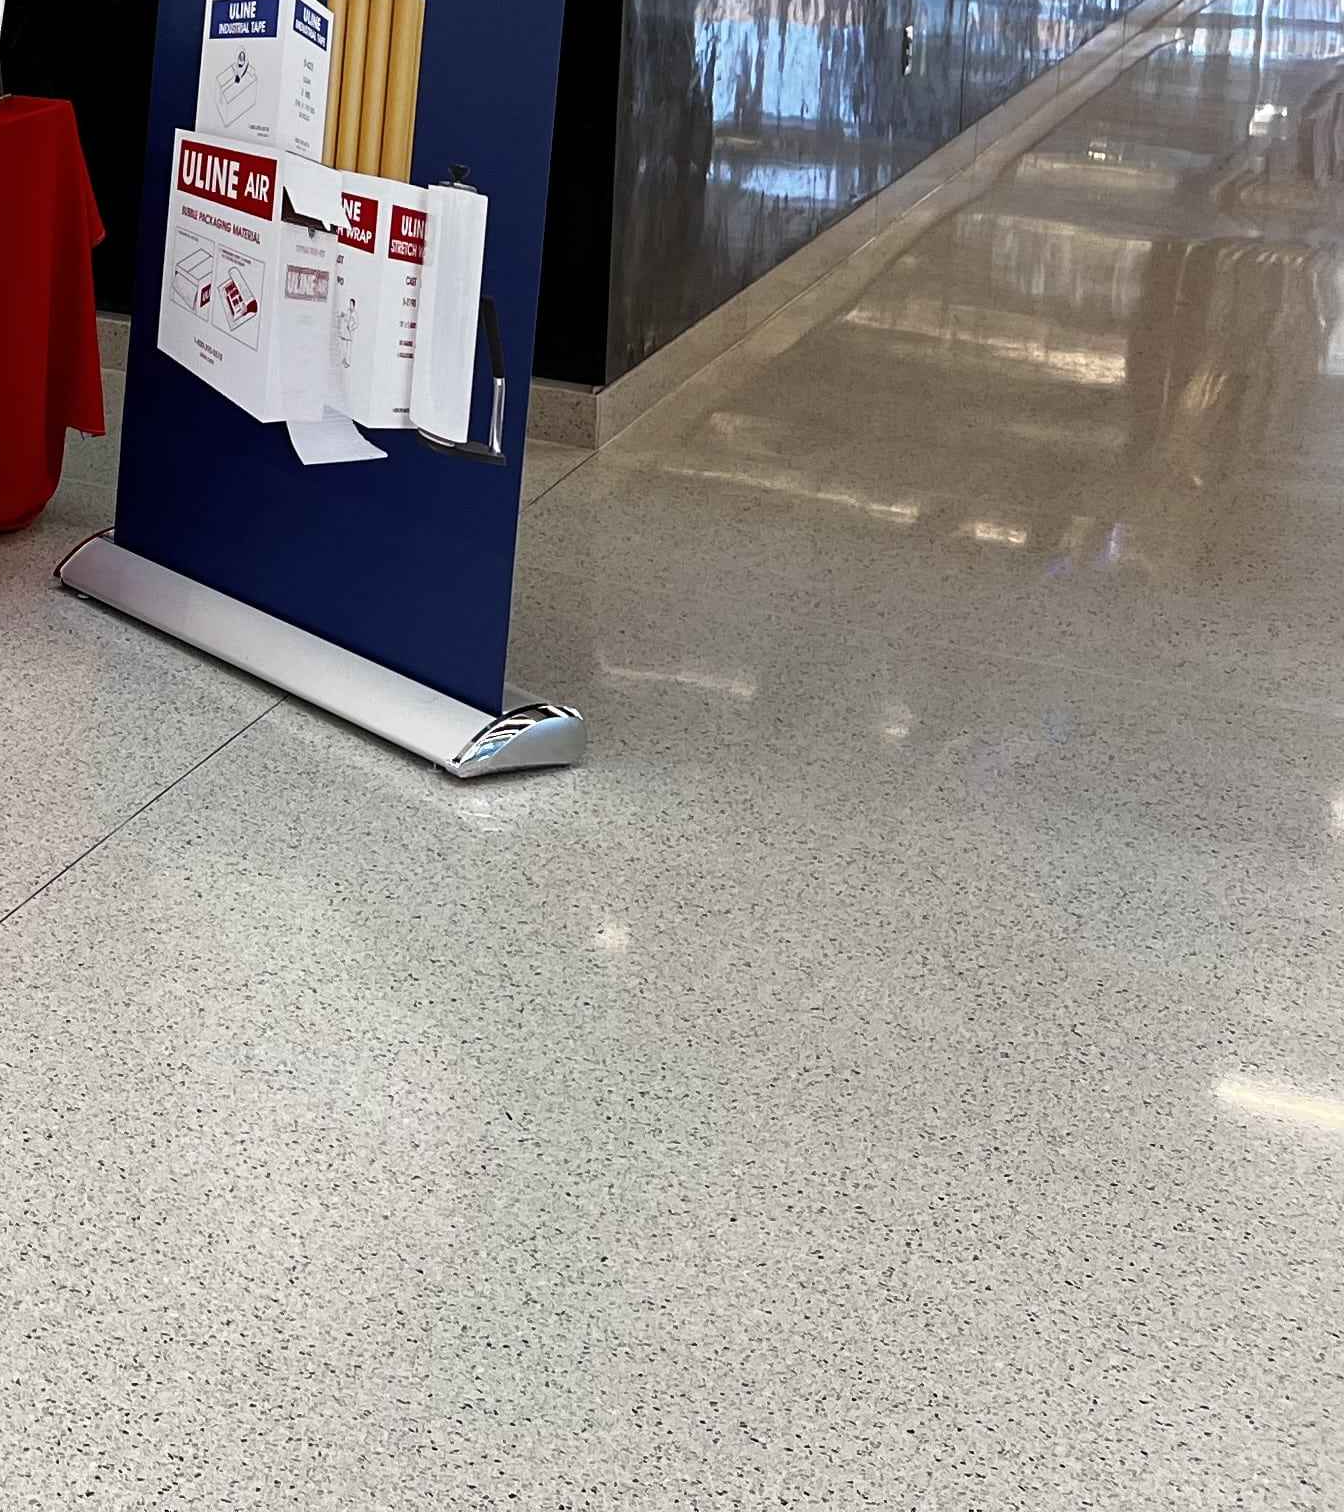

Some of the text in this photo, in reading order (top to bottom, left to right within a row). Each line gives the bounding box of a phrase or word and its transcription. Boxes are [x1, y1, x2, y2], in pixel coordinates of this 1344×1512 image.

[229, 1, 257, 20] ULINE
[218, 21, 267, 34] INDUSTRIAL TAPE
[182, 149, 270, 203] ULINE AIR
[199, 211, 232, 233] PACKAGING
[232, 224, 261, 245] MATERIAL
[346, 225, 373, 244] WRAP
